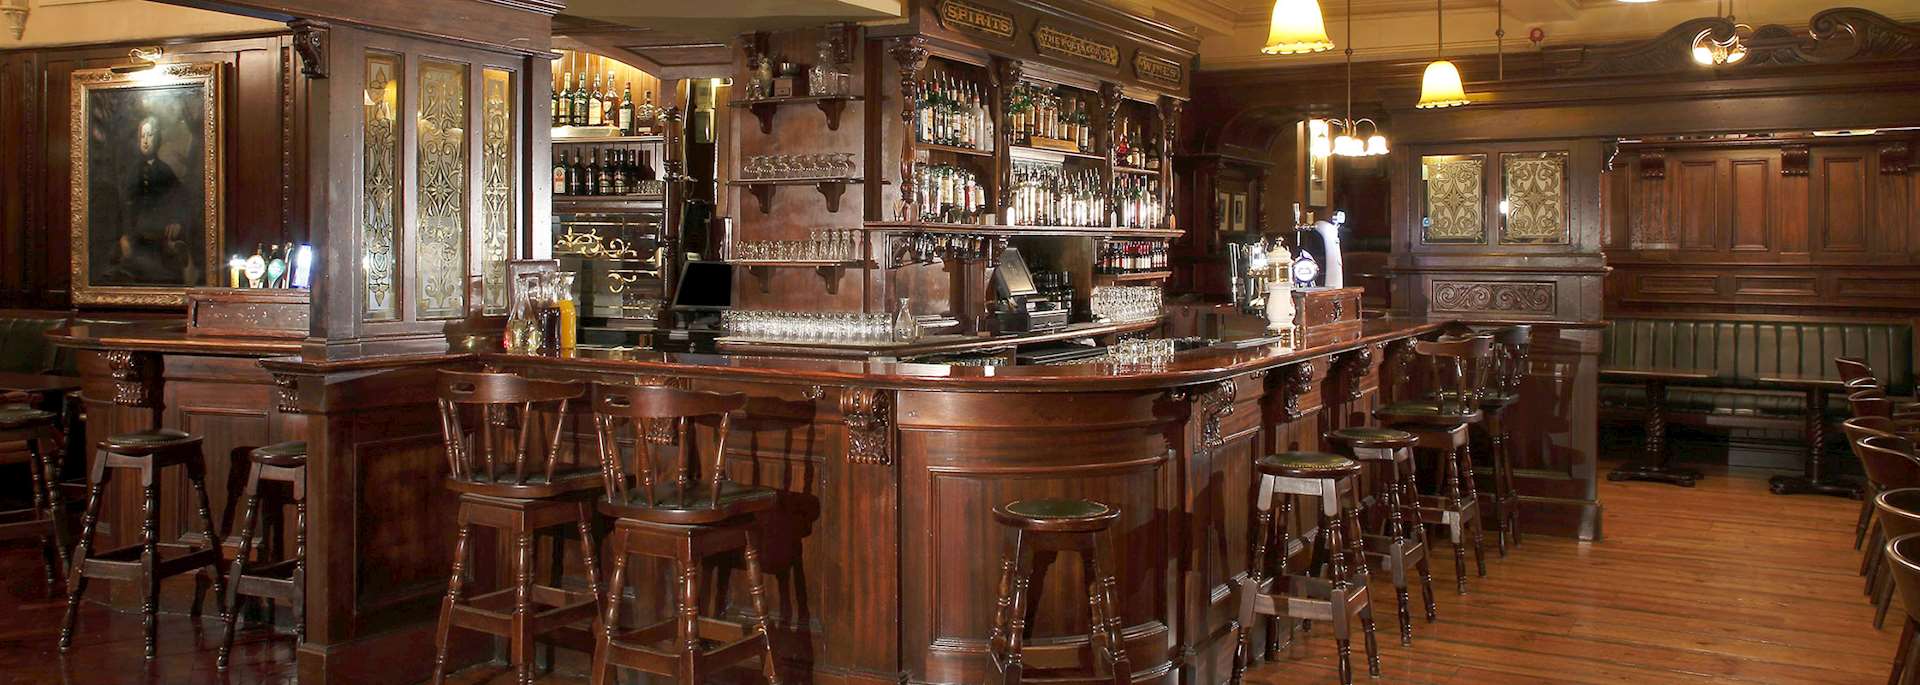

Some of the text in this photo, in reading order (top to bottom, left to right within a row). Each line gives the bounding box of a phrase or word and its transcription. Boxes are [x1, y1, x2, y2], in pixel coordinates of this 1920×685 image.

[947, 5, 1010, 32] SPIRITS
[1043, 32, 1060, 47] THE
[1142, 60, 1177, 78] WINES
